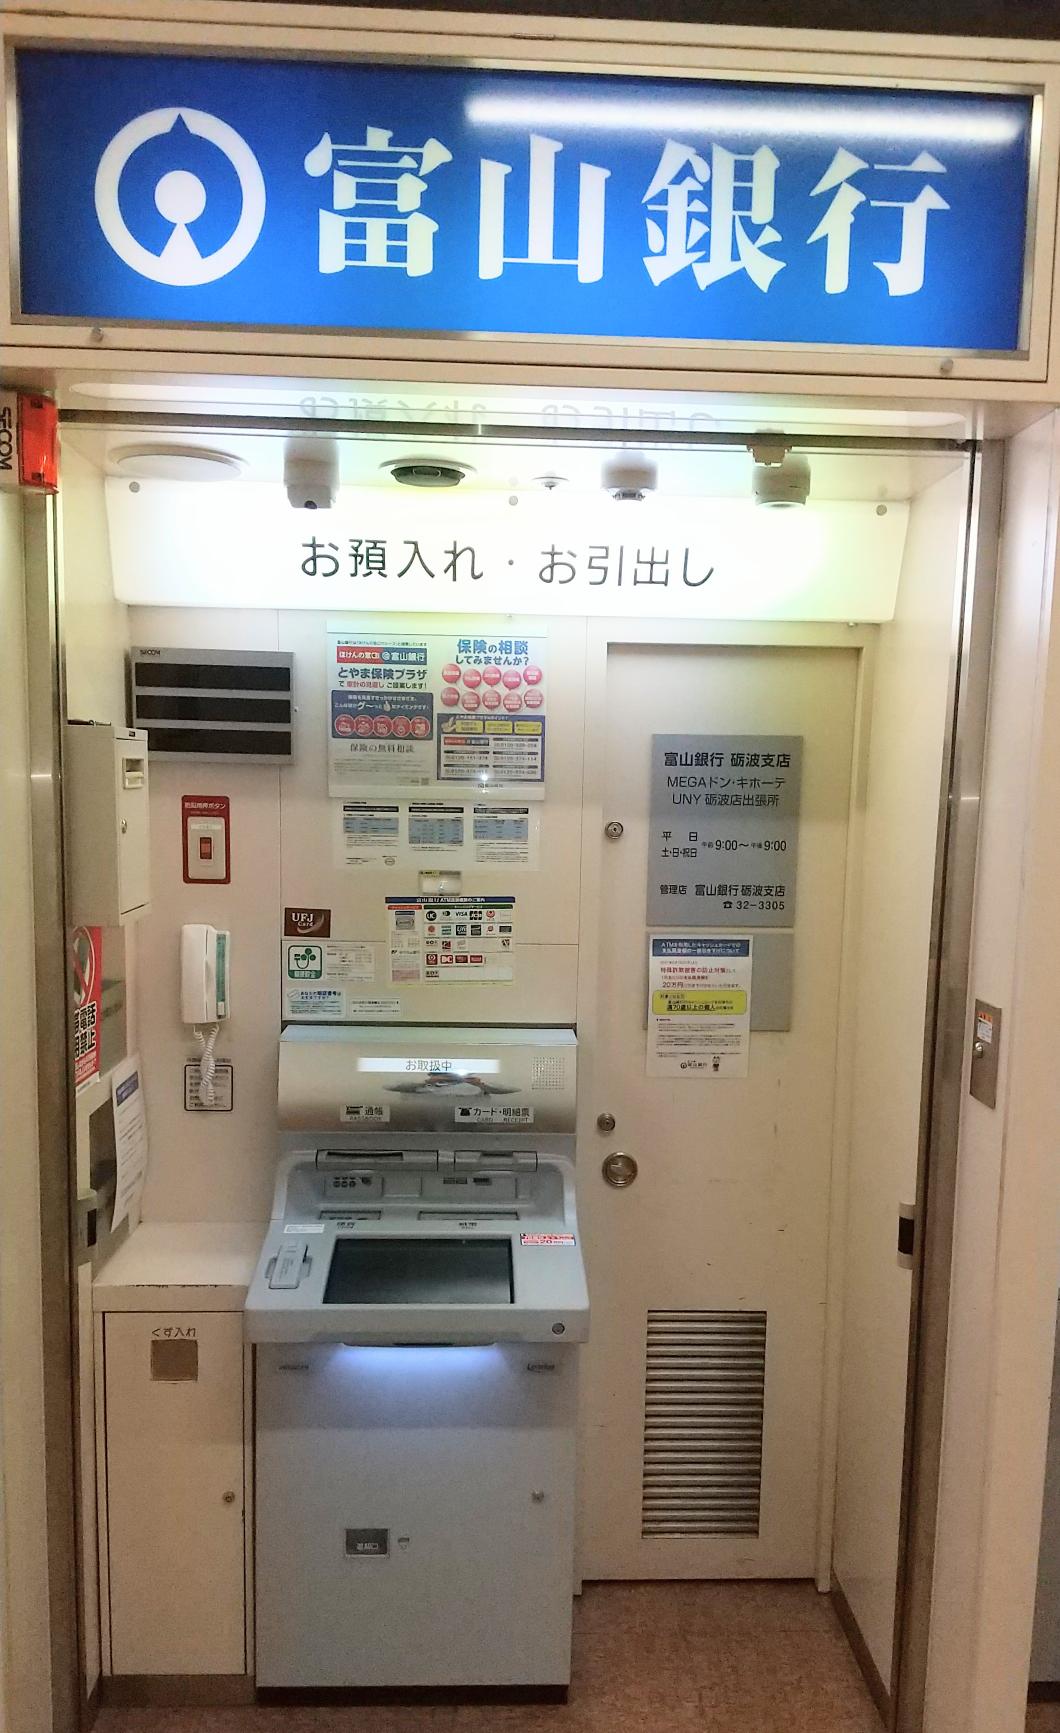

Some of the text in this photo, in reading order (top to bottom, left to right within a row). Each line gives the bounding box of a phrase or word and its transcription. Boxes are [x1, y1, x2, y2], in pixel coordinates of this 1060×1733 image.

[304, 126, 951, 297] 富山銀行
[299, 534, 717, 591] お預入れ・お引出し
[457, 639, 529, 655] 保険の相談
[337, 667, 428, 680] とやま保険プラザ
[664, 753, 791, 768] 富山銀行 砺波支店
[672, 794, 780, 807] UNY 砺波店出張所
[291, 912, 314, 922] UFJ
[405, 1060, 452, 1072] お取扱中
[364, 1106, 383, 1116] 通帳
[472, 1107, 530, 1117] カード・明細票
[151, 1327, 196, 1338] くず入れ
